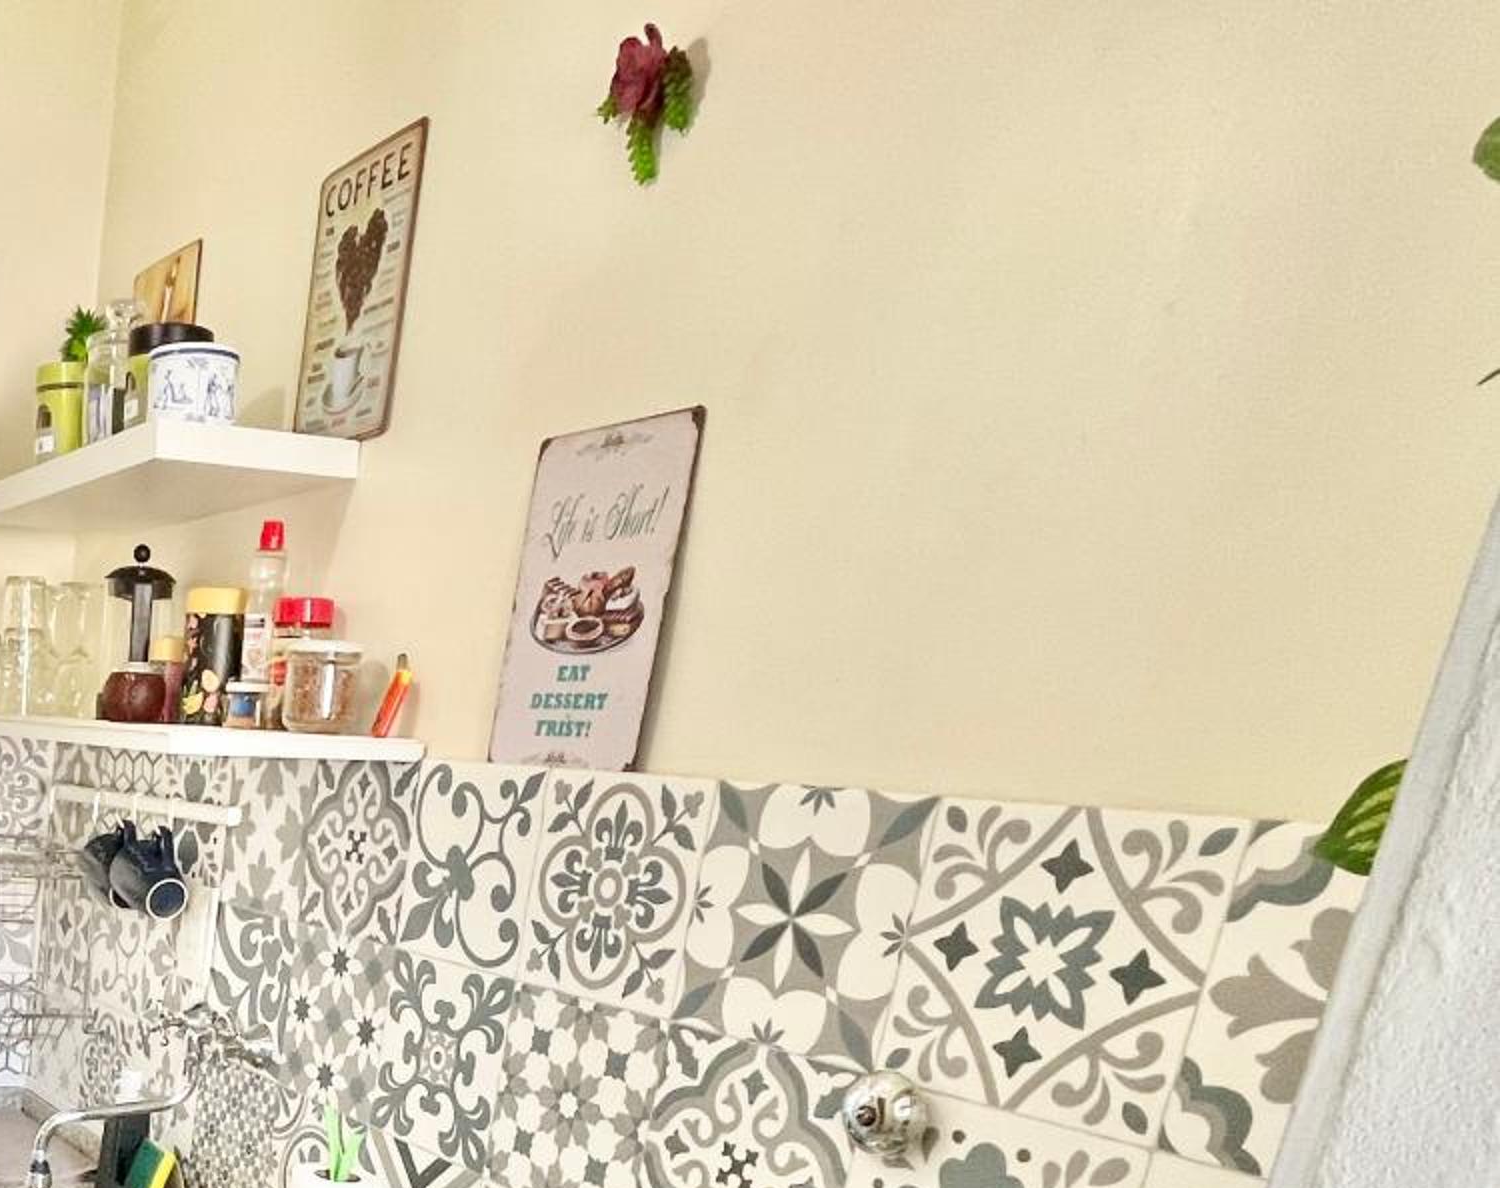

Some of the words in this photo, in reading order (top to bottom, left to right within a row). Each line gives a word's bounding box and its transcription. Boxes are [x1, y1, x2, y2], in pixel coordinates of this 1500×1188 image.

[325, 142, 413, 218] COFFEE
[556, 664, 591, 682] EAT
[530, 692, 609, 711] DESSERT
[534, 719, 593, 737] FRIST!
